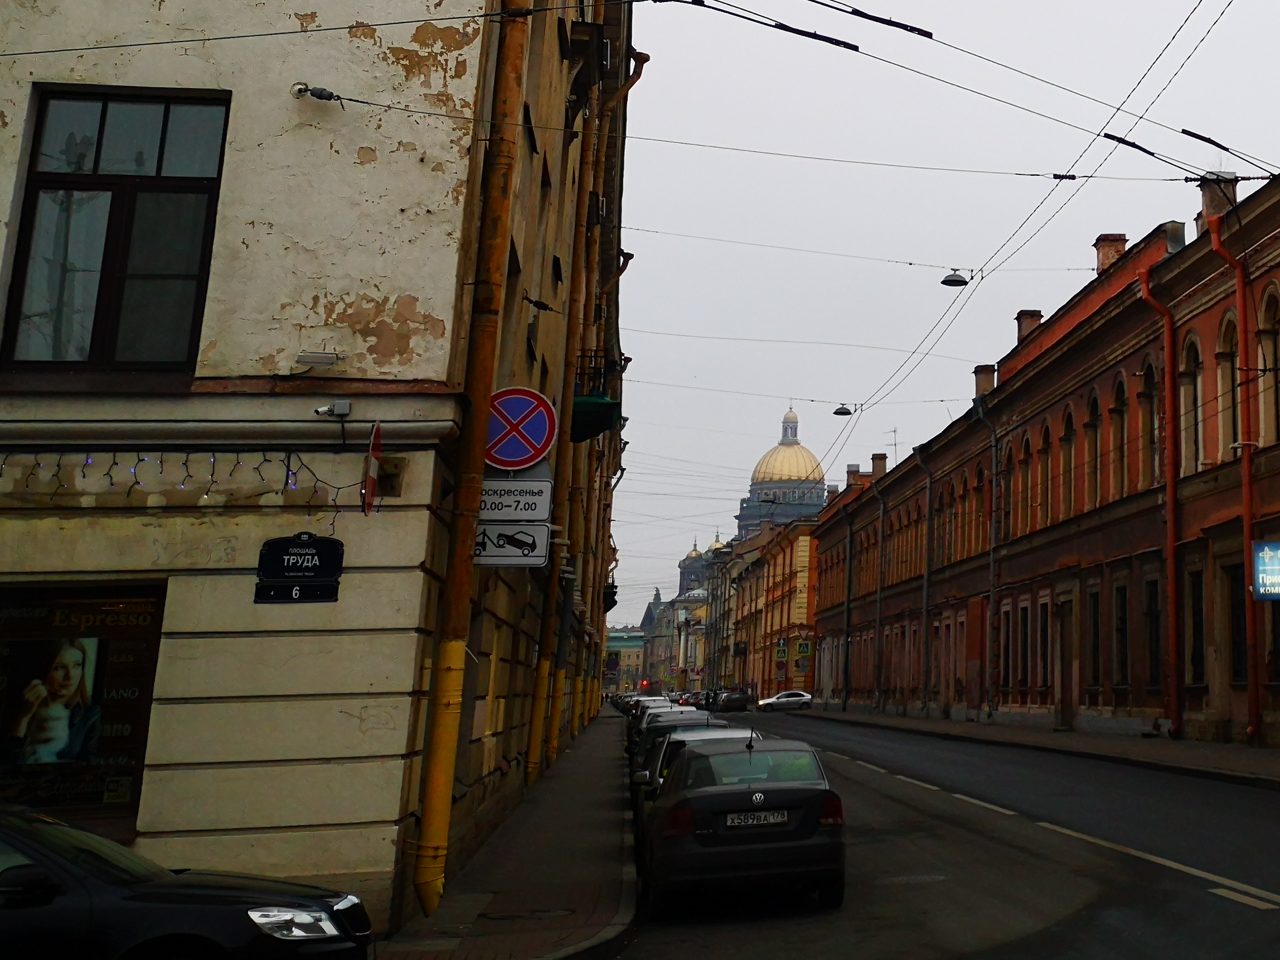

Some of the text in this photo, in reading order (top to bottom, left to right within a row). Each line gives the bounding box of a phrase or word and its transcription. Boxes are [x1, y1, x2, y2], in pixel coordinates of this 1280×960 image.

[480, 488, 544, 498] оскресенье
[282, 555, 320, 568] ТРУДА
[291, 586, 300, 599] 6
[51, 608, 152, 631] Espresso
